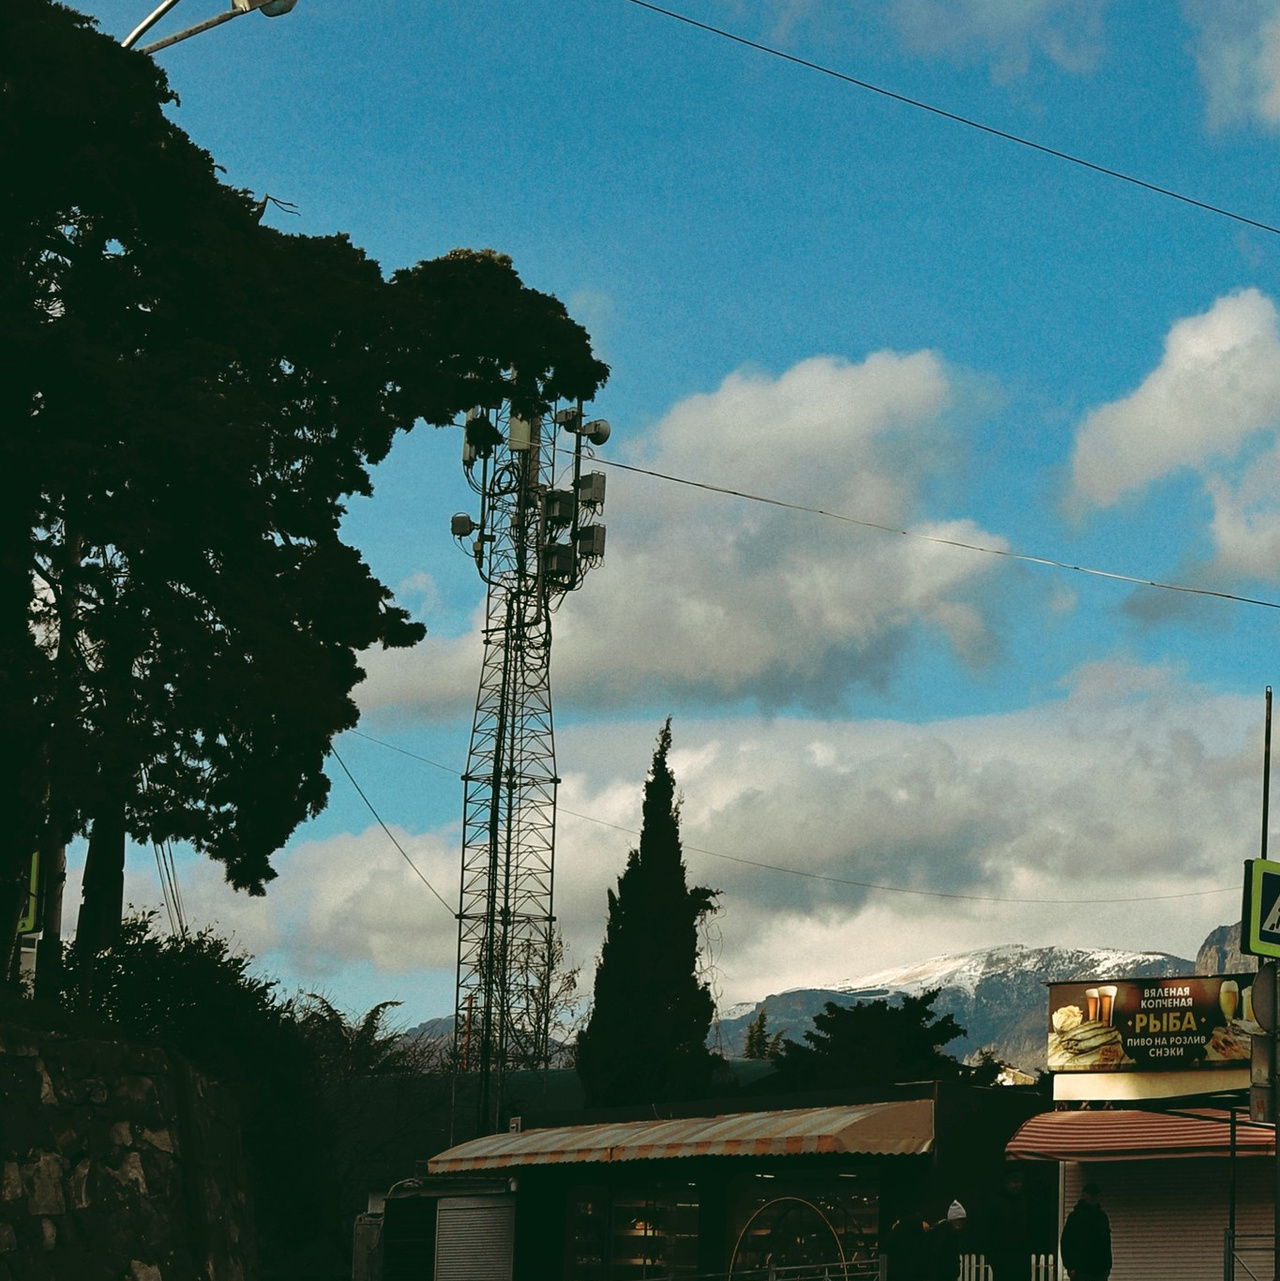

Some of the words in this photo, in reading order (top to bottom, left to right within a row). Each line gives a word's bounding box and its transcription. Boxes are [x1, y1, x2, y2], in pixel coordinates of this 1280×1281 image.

[1144, 986, 1190, 998] ВЯЛЕНАЯ
[1141, 998, 1193, 1009] КОПЧЕНАЯ
[1135, 1011, 1197, 1033] РЫБА
[1127, 1038, 1153, 1047] ПИВО
[1155, 1037, 1167, 1045] НА
[1170, 1036, 1206, 1045] РОЗЛИВ
[1149, 1047, 1184, 1057] СНЭКИ
